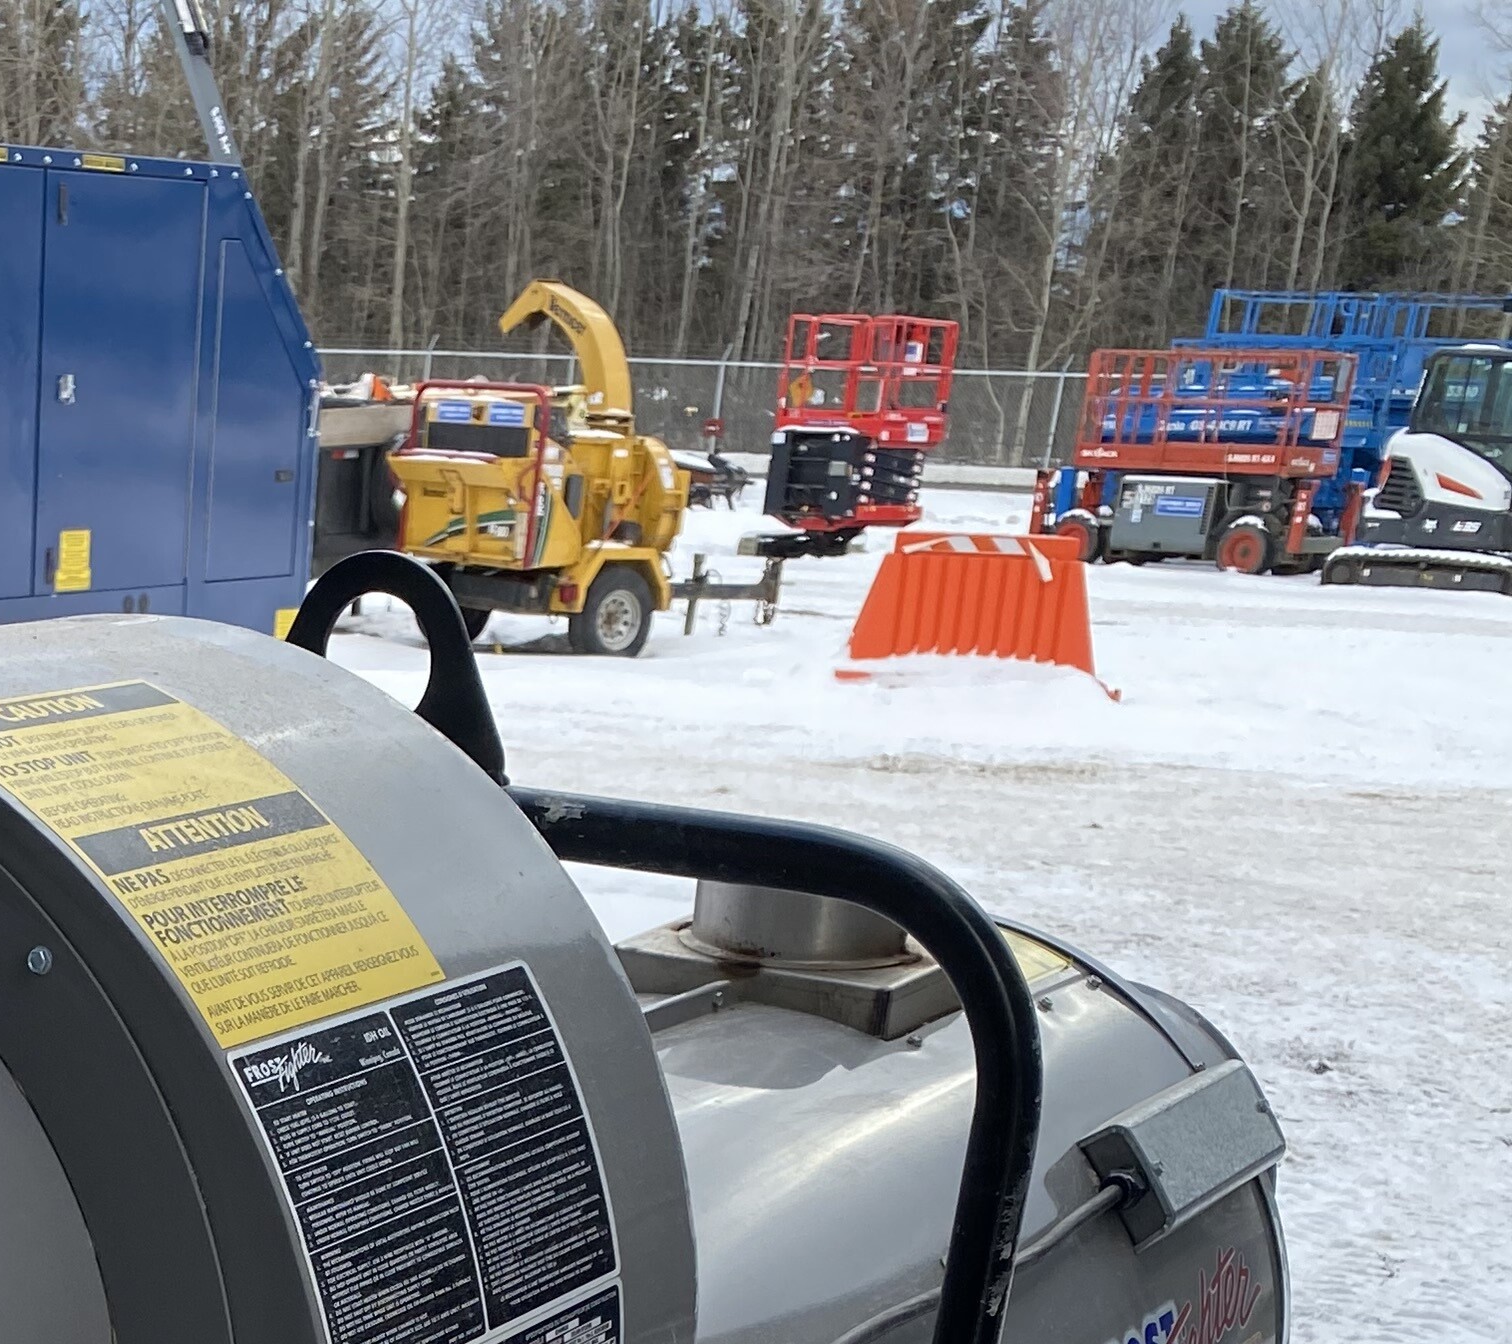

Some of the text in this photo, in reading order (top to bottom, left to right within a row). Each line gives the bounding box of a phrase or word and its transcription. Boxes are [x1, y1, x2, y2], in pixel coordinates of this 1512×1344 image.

[10, 757, 63, 774] STOP
[51, 750, 101, 766] UNIT
[136, 804, 272, 853] ATTENTION
[111, 868, 172, 895] NE PAS
[140, 874, 308, 930] POUR INTERROMPRE LE
[153, 897, 294, 948] FONCTIONNEMENT
[243, 1036, 331, 1096] FROST Fighter
